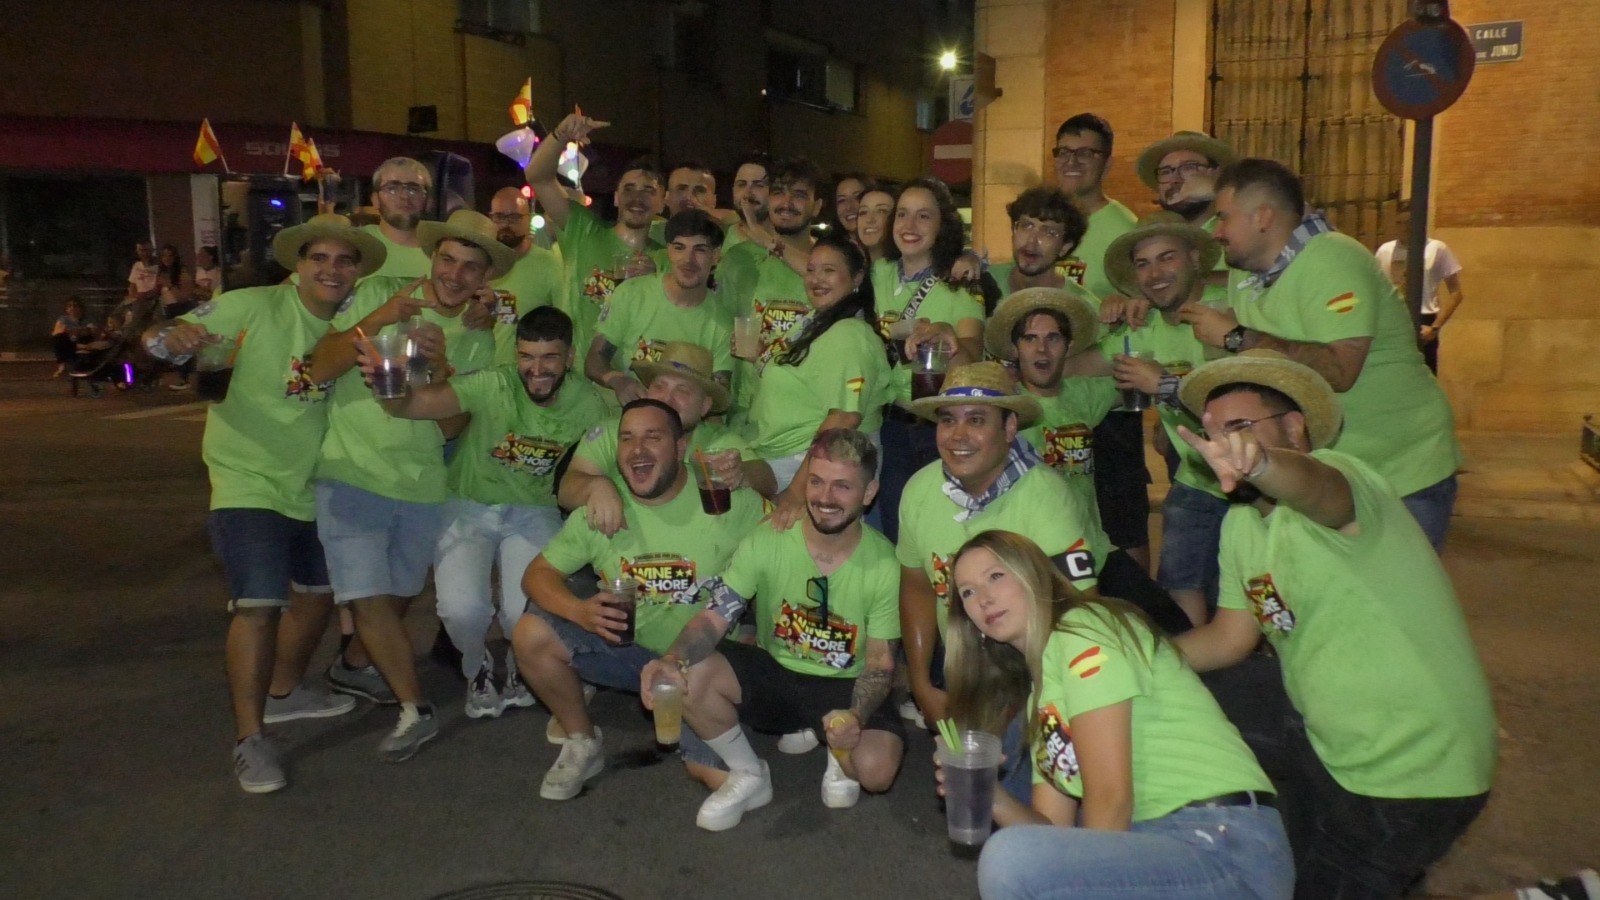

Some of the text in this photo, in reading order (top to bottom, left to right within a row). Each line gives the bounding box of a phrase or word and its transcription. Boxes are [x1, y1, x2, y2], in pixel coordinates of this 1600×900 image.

[1475, 27, 1508, 40] CALLE
[1490, 43, 1519, 57] JUNIO
[1066, 552, 1092, 577] C
[633, 566, 673, 580] WINE
[645, 579, 689, 591] SHORE
[798, 632, 847, 652] SHORE
